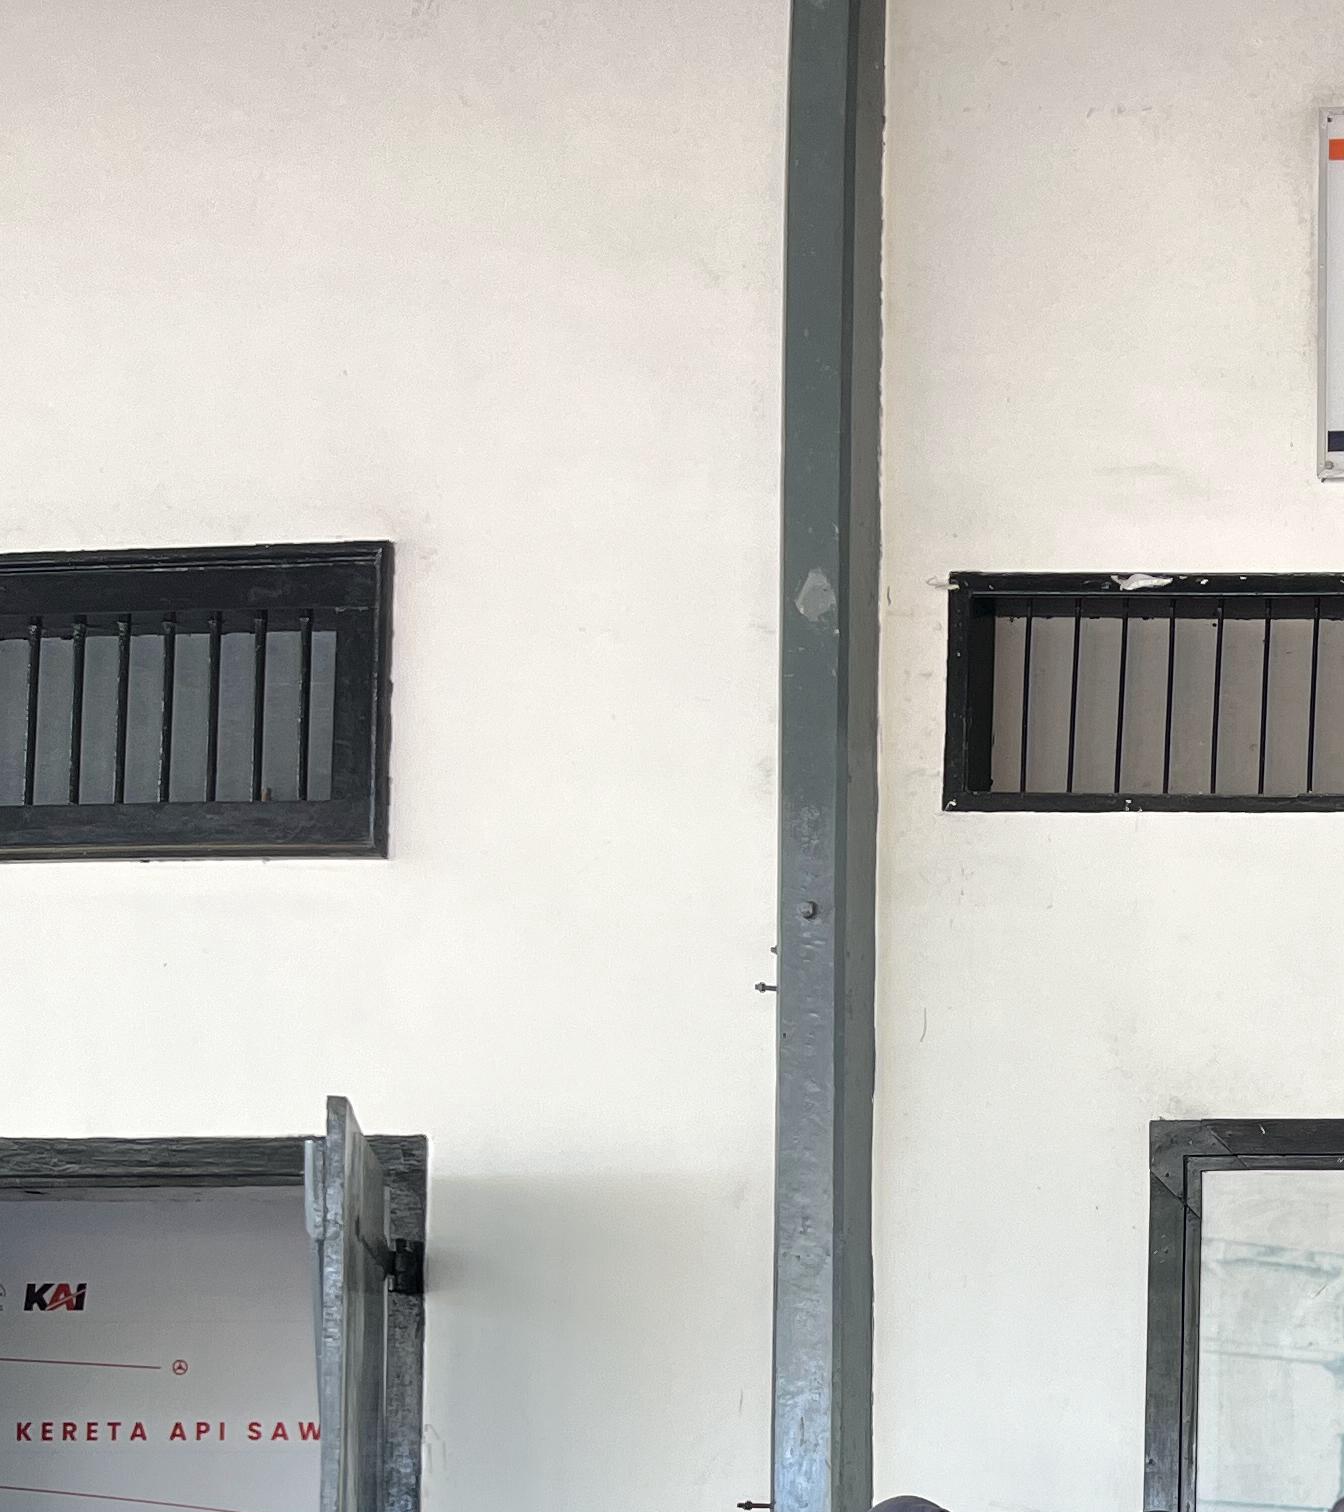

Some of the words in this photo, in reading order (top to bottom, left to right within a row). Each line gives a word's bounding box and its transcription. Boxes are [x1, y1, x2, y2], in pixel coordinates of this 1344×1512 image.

[24, 1283, 88, 1311] KAI
[16, 1422, 148, 1442] KERETA
[169, 1421, 226, 1442] API
